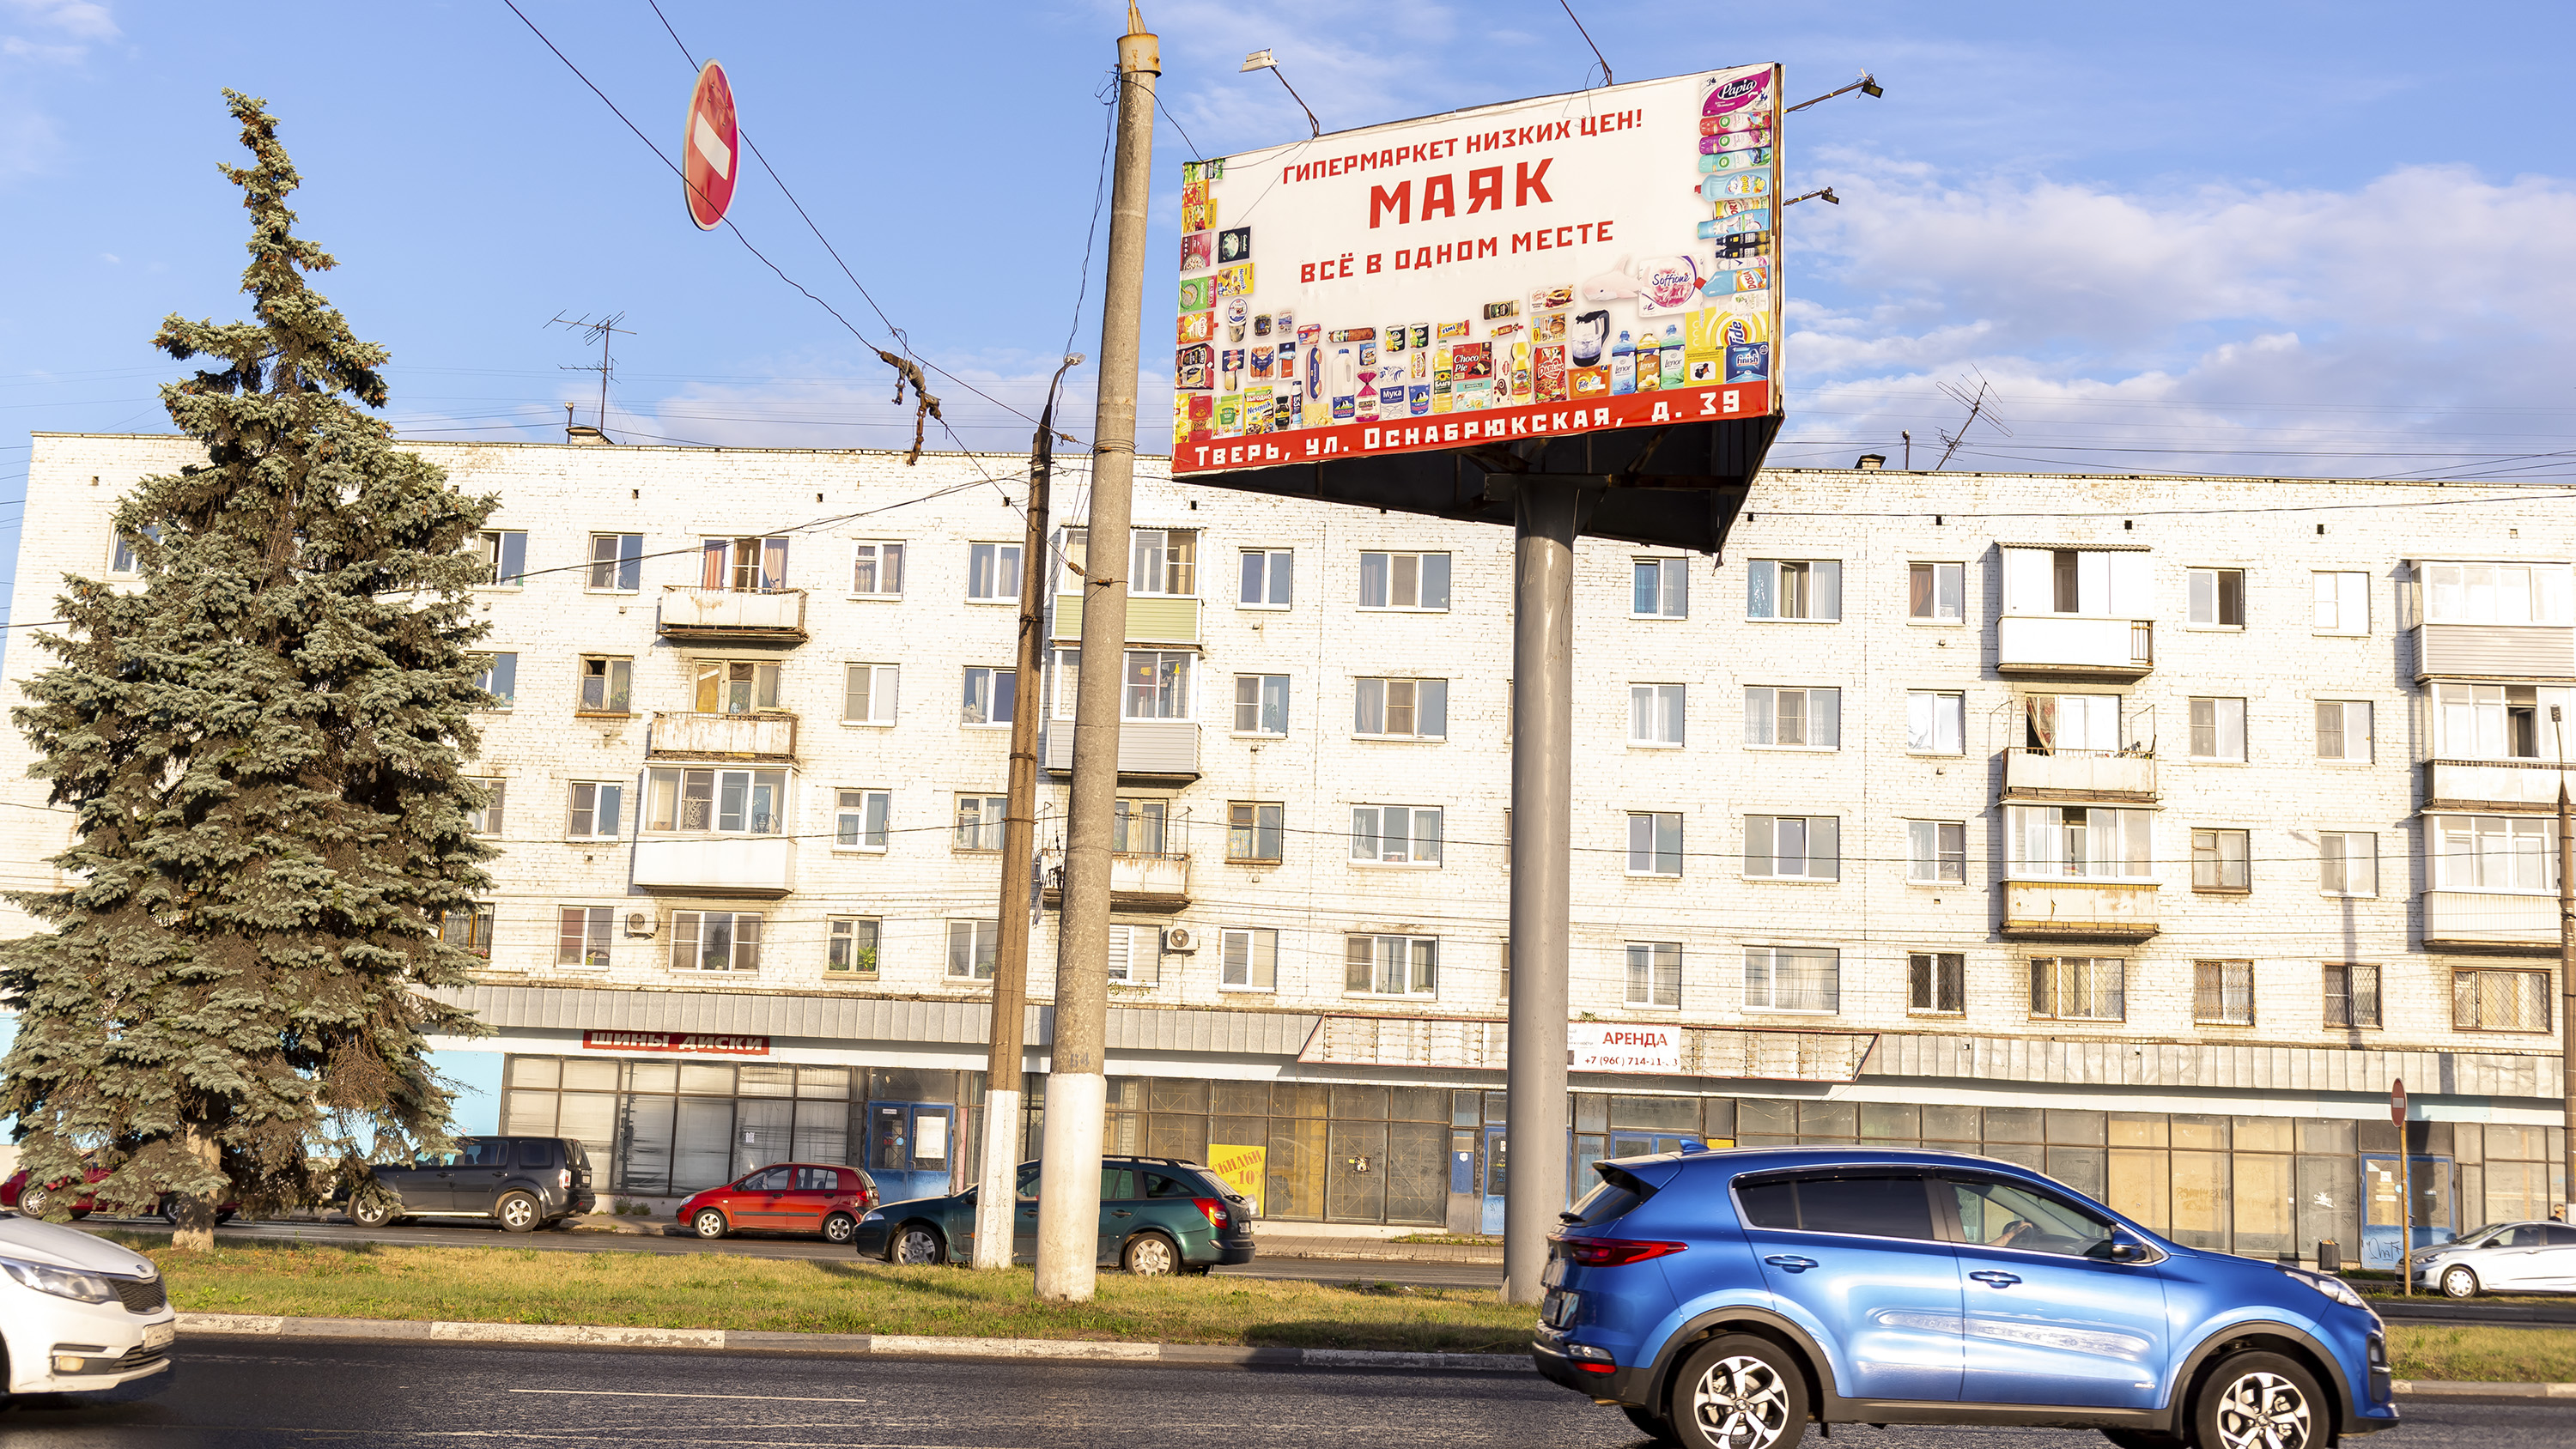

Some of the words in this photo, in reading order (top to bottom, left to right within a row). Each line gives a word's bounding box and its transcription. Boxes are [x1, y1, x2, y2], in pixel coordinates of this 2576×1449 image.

[1721, 78, 1757, 99] Papia
[1283, 138, 1458, 185] ГИПЕРМАРКЕТ
[1466, 120, 1571, 155] НИЗКИХ
[1581, 108, 1642, 136] ЦЕН!
[1370, 157, 1554, 229] МАЯК
[1301, 252, 1354, 283] ВСЁ
[1366, 253, 1382, 275] В
[1395, 236, 1498, 270] ОДНОМ
[1512, 220, 1613, 254] МЕСТЕ
[1238, 268, 1247, 290] Nesquik
[1651, 273, 1691, 287] Soffione
[1743, 270, 1757, 290] DOSIA
[1453, 354, 1479, 364] Choco
[1639, 361, 1657, 371] Lenor
[1664, 359, 1683, 368] Lenor
[1737, 353, 1759, 364] finish
[1455, 364, 1467, 373] Pie
[1538, 362, 1564, 378] DARLING
[1615, 365, 1632, 374] Lenor
[1382, 389, 1402, 399] Мука
[1247, 401, 1272, 415] Nesquik
[1699, 390, 1740, 415] 39
[590, 1032, 670, 1048] ШИНЫ
[678, 1035, 762, 1051] ДИСКИ
[1602, 1032, 1668, 1048] АРЕНДА
[1585, 1056, 1596, 1064] +7
[1212, 1150, 1262, 1175] СКИДКИ
[1238, 1169, 1263, 1185] 10%
